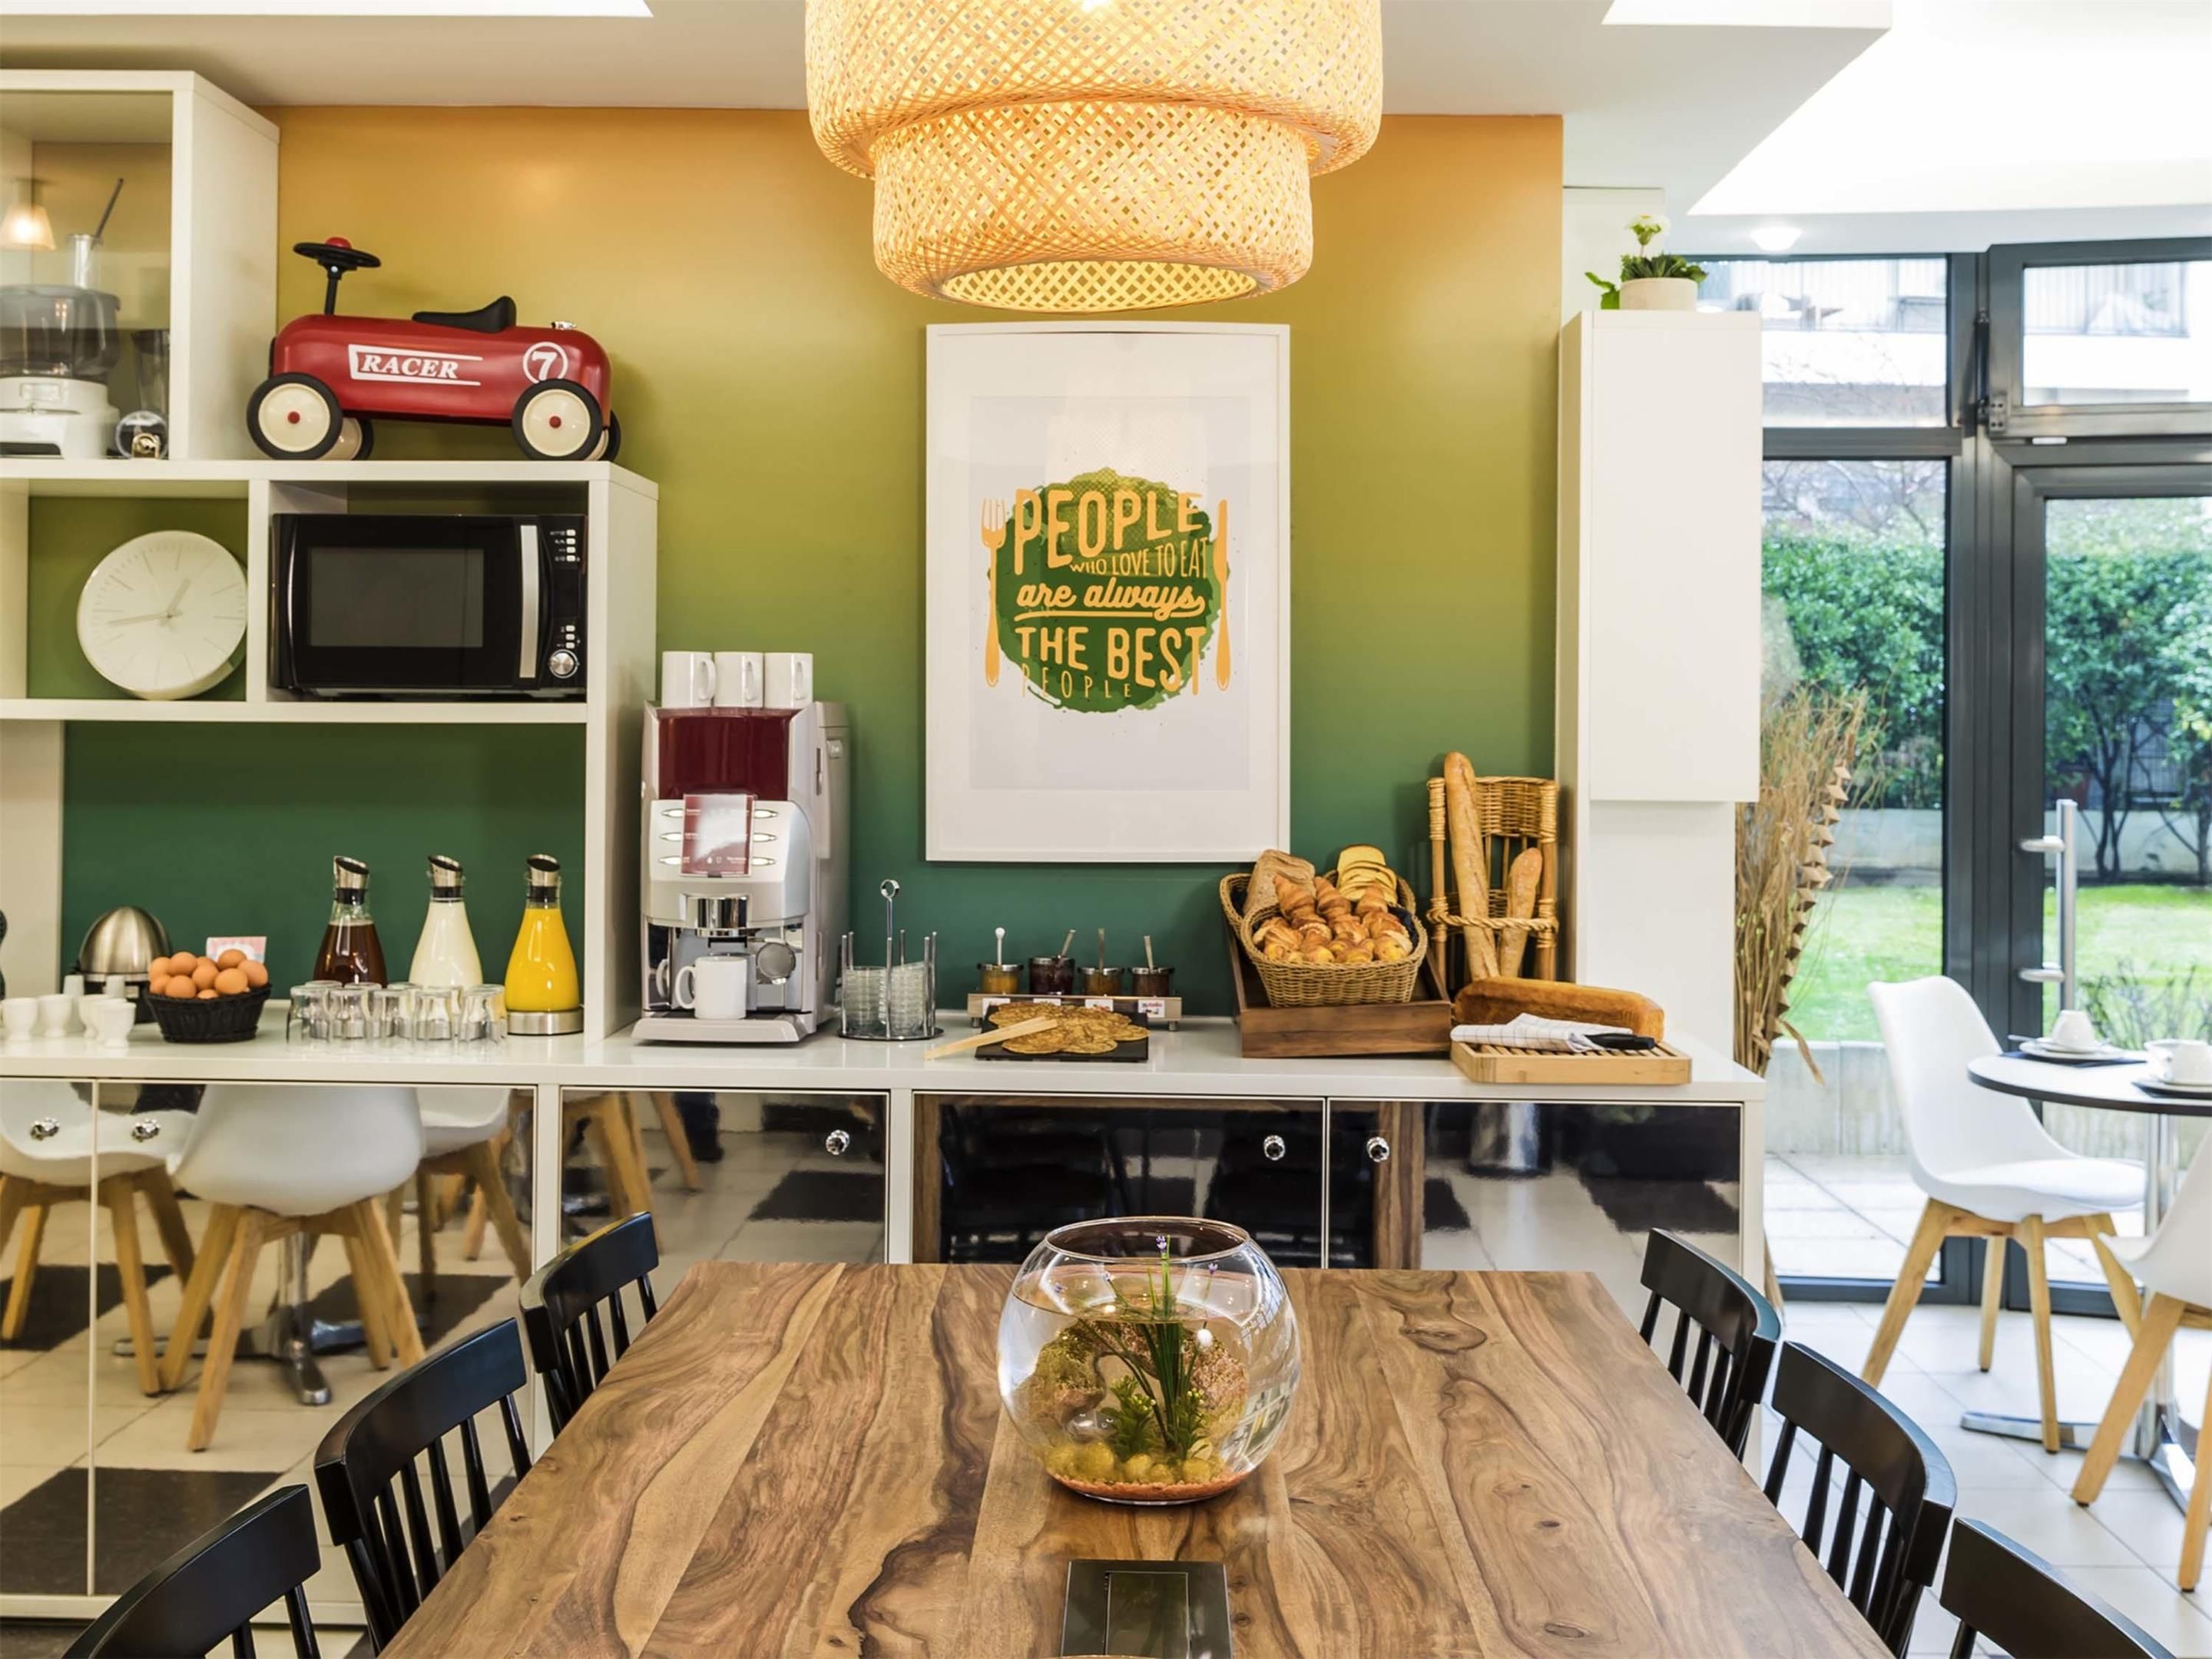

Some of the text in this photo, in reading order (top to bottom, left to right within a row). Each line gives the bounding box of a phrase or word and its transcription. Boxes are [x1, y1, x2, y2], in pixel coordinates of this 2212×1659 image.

[362, 354, 459, 379] RACER
[532, 351, 557, 381] 7
[1015, 488, 1204, 575] PEOPLE
[1070, 538, 1208, 578] WHO LOVE TO EAT
[1016, 576, 1206, 621] are always
[1015, 627, 1207, 695] THE BEST
[1022, 664, 1132, 698] PEOPLE
